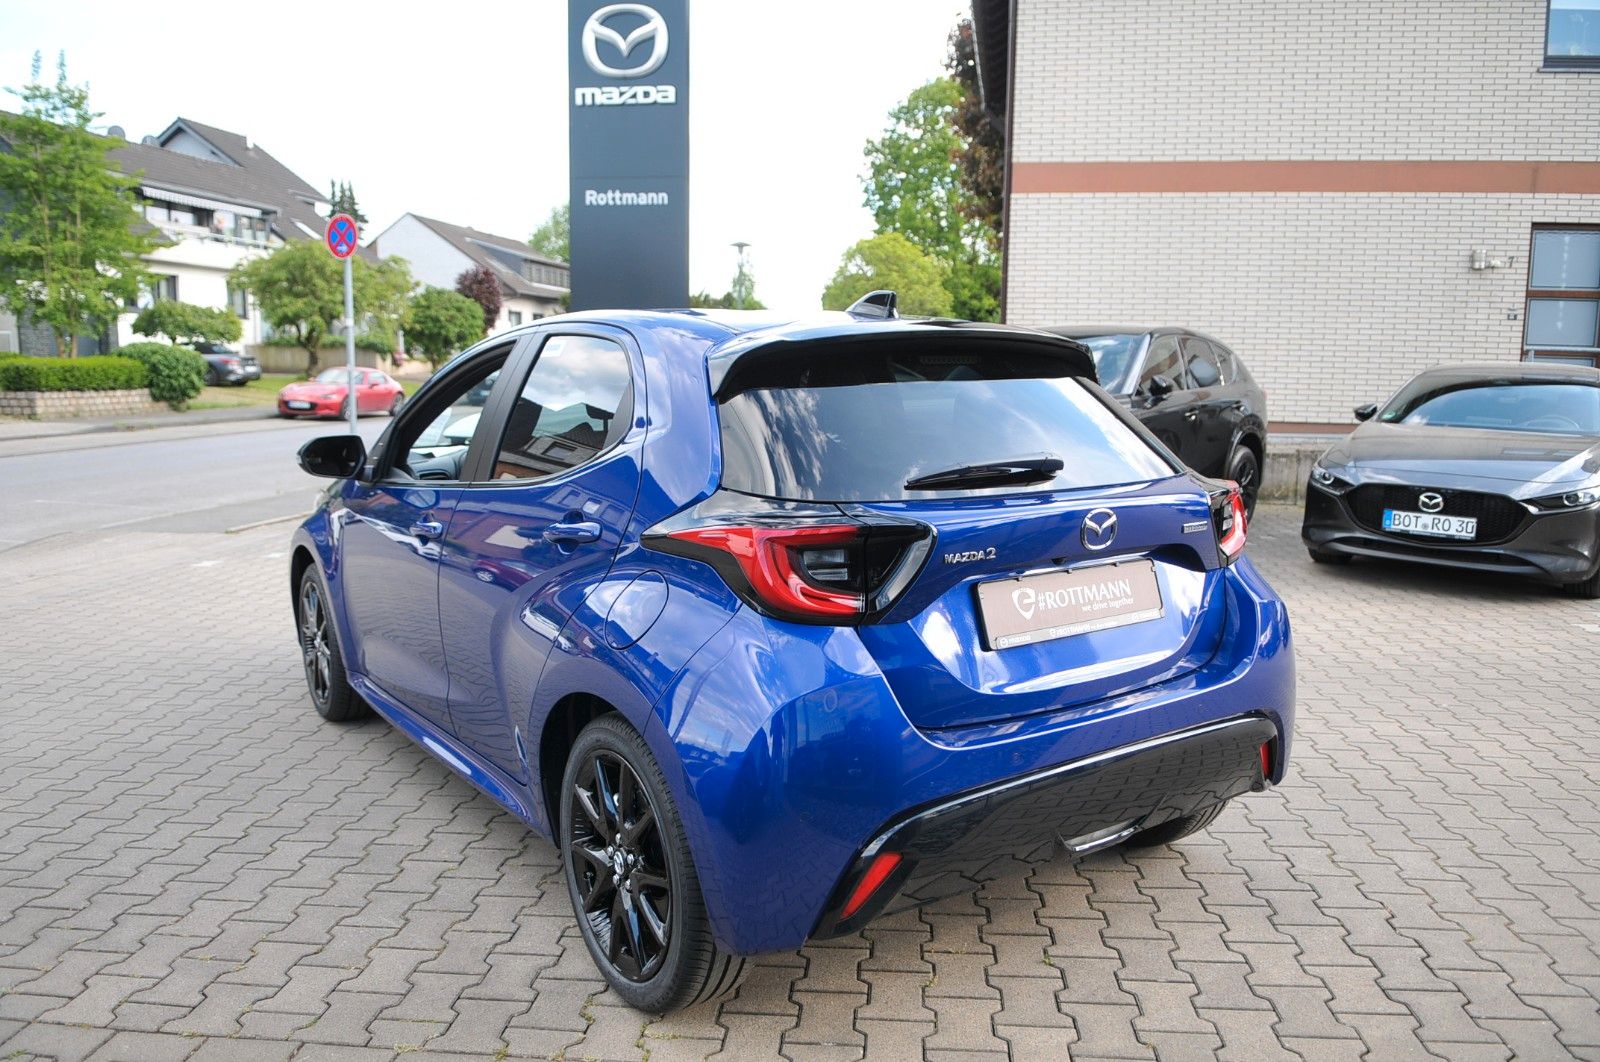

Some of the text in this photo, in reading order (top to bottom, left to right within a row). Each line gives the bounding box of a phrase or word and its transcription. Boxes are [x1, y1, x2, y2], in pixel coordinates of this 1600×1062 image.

[574, 84, 676, 106] mazda
[585, 189, 668, 206] Rottmann
[1392, 513, 1475, 534] BOT RO 30
[1038, 579, 1132, 610] #ROTTMANN
[1081, 597, 1134, 612] we drive together
